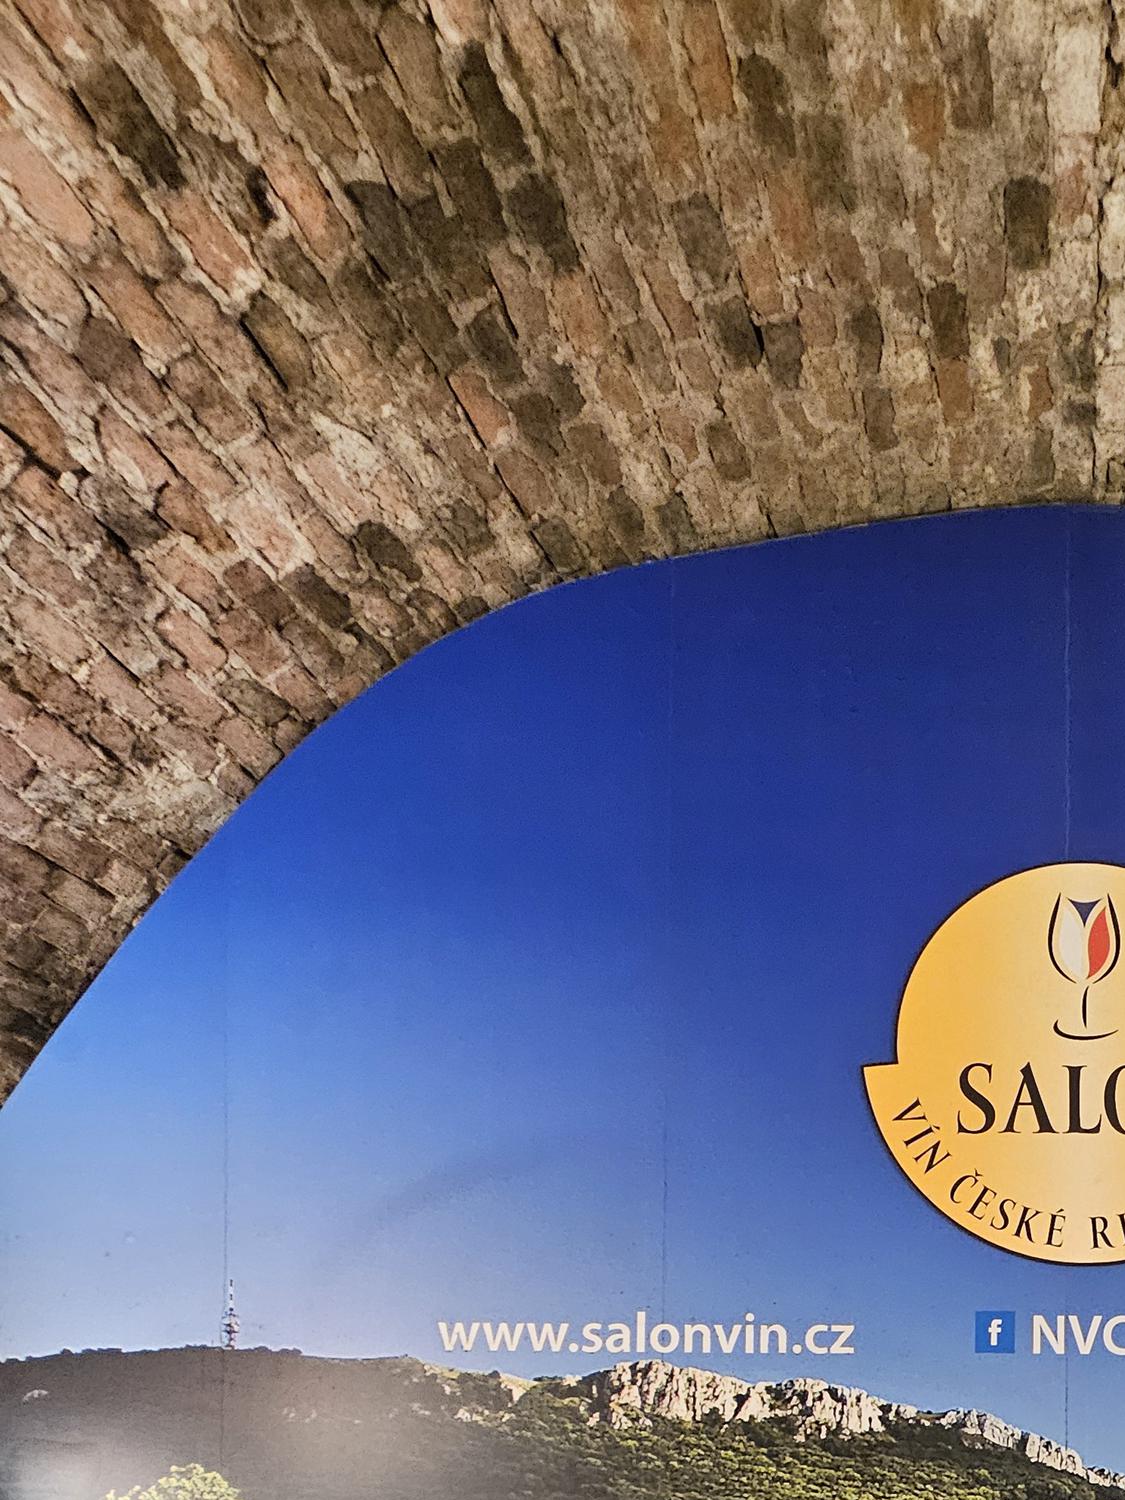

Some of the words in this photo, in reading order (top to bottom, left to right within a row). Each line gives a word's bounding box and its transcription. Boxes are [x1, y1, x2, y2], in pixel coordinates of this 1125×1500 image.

[891, 1097, 952, 1175] VÍN
[949, 1168, 1067, 1249] ČESKÉ
[437, 1311, 856, 1356] www.salonvin.cz
